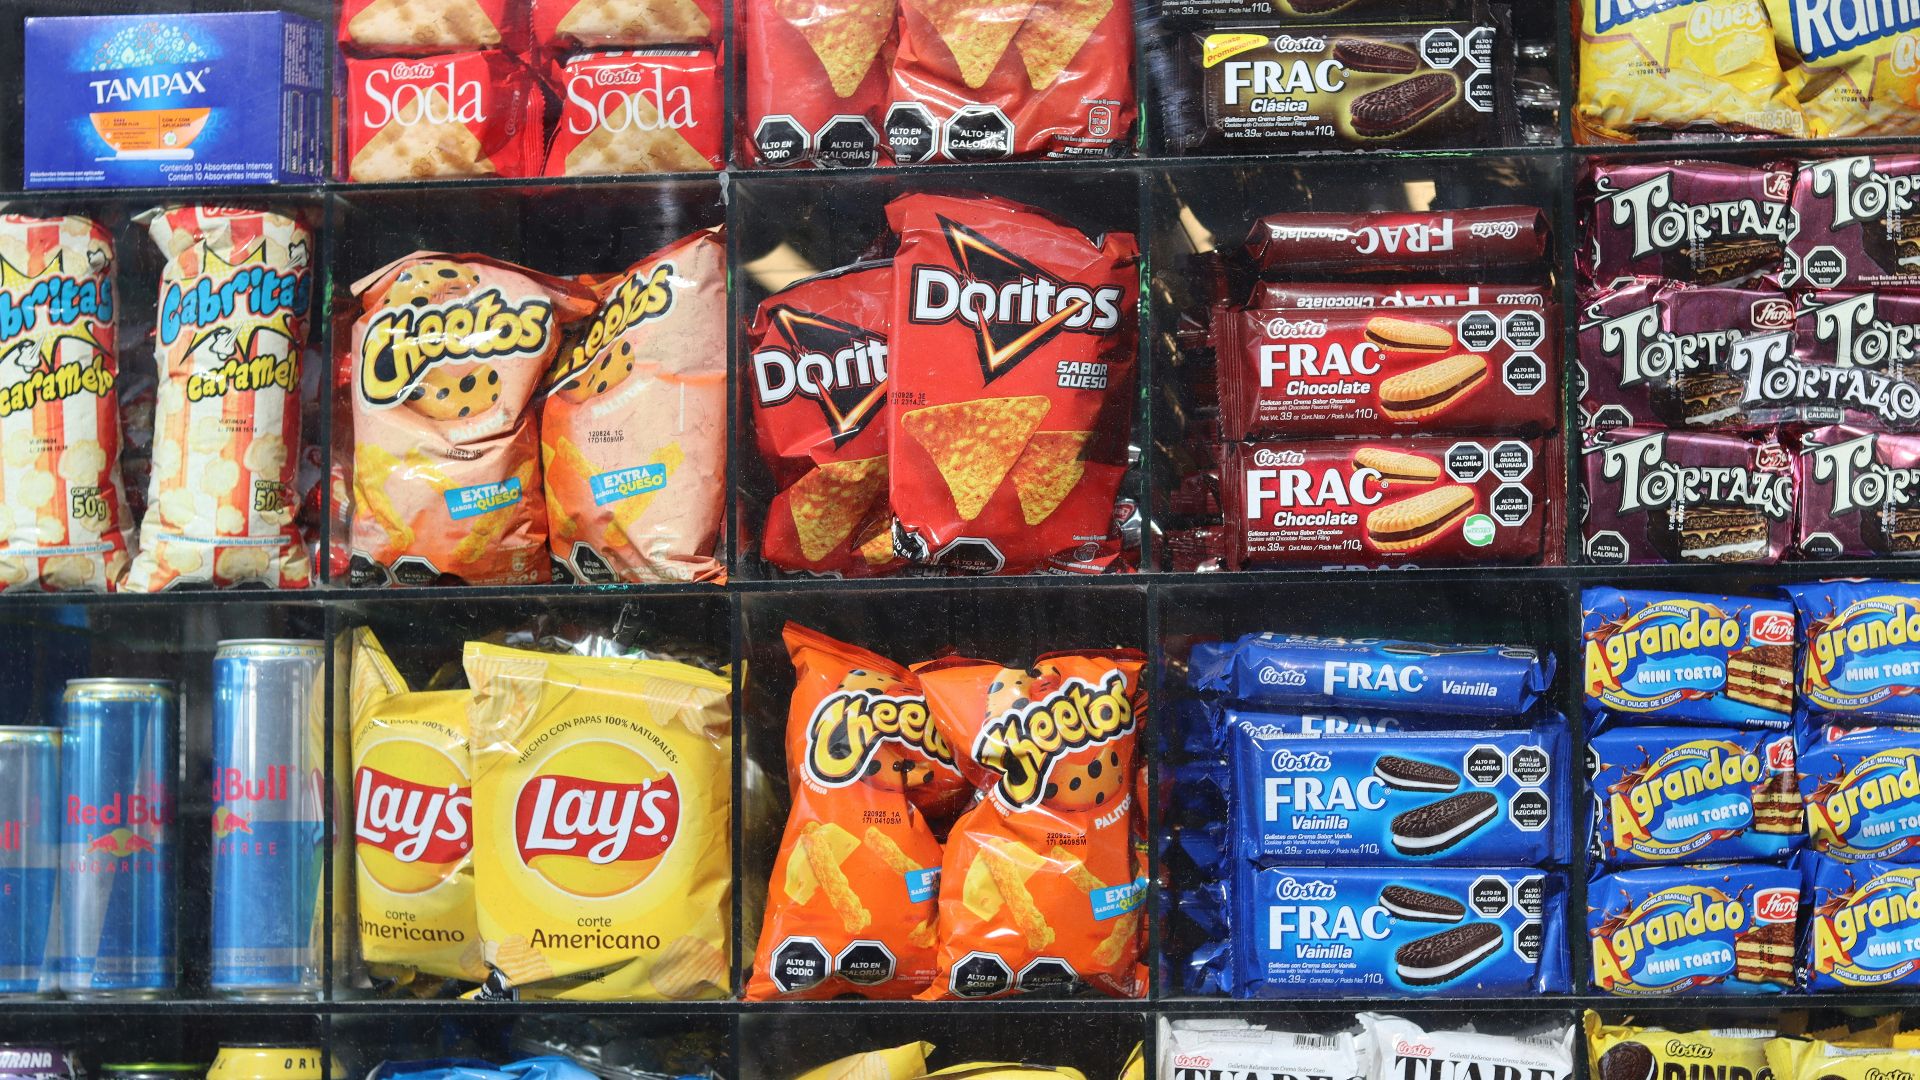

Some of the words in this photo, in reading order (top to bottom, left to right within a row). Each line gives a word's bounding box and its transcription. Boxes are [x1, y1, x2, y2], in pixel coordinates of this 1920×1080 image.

[1207, 37, 1260, 62] Promocional
[1275, 35, 1325, 52] Costa
[1427, 46, 1457, 54] CALORÍAS
[391, 62, 435, 79] Costa
[596, 67, 641, 85] Costa
[89, 69, 206, 104] TAMPAX
[1224, 60, 1346, 105] FRAC
[364, 63, 487, 129] Soda
[568, 68, 698, 135] Soda
[1250, 98, 1308, 113] Clásica
[889, 127, 909, 136] ALTO
[911, 127, 922, 136] EN
[960, 129, 982, 138] ALTO
[1314, 125, 1335, 137] 110g
[831, 141, 850, 150] ALTO
[852, 141, 864, 149] EN
[889, 136, 919, 147] SODIO
[159, 163, 193, 172] Contenido
[203, 162, 244, 171] Absorbentes
[246, 161, 273, 170] Internos
[168, 172, 193, 182] Contém
[195, 172, 202, 180] 10
[203, 171, 245, 180] Absorventes
[246, 170, 272, 180] Internos
[1271, 227, 1348, 243] Chocolate
[1355, 218, 1454, 254] FRAC
[1469, 220, 1518, 240] Costa
[160, 265, 310, 346] Cabritas
[914, 263, 1123, 330] Doritos
[1266, 317, 1326, 339] Costa
[361, 289, 551, 403] Cheetos
[753, 339, 888, 405] Dorit
[1057, 360, 1108, 376] SABOR
[1260, 342, 1380, 387] FRAC
[0, 354, 115, 417] caramelo
[1058, 375, 1107, 390] QUESO
[1286, 380, 1371, 396] Chocolate
[1354, 408, 1373, 418] 110
[1254, 448, 1304, 466] Costa
[595, 489, 615, 499] SABOR
[618, 474, 663, 495] QUESO
[603, 467, 651, 489] EXTRA
[450, 503, 474, 513] SABOR
[476, 488, 519, 511] QUESO
[460, 483, 508, 503] EXTRA
[1247, 469, 1383, 519] FRAC
[72, 497, 107, 521] 50g
[1495, 503, 1527, 511] AZÚCARES
[1273, 511, 1358, 527] Chocolate
[1342, 539, 1362, 551] 110g
[1638, 604, 1661, 620] DOBLE
[1662, 605, 1690, 617] MANJAR
[1867, 602, 1896, 613] MANJAR
[1584, 609, 1740, 696] Agrandao
[1258, 665, 1307, 686] Costa
[1323, 661, 1425, 696] FRAC
[1441, 679, 1498, 697] Vainilla
[1638, 668, 1673, 684] MINI
[1675, 665, 1723, 680] TORTA
[1846, 666, 1881, 682] MINI
[1884, 663, 1920, 678] TORT
[1603, 692, 1626, 705] DOBLE
[1627, 699, 1648, 708] DULCE
[1648, 699, 1657, 707] DE
[1658, 690, 1682, 706] LECHE
[1813, 690, 1835, 704] DOBLE
[1836, 697, 1858, 706] DULCE
[1858, 696, 1868, 705] DE
[1868, 688, 1891, 703] LECHE
[421, 720, 445, 734] 100%
[519, 738, 549, 764] HECHO
[549, 720, 573, 738] CON
[572, 715, 603, 728] PAPAS
[604, 715, 629, 730] 100%
[629, 722, 678, 764] NATURALES
[975, 676, 1133, 804] Cheetos
[1272, 748, 1332, 772] Costa
[1659, 752, 1680, 767] DOBLE
[1681, 748, 1709, 759] MANJAR
[1854, 760, 1876, 775] DOBLE
[1876, 757, 1906, 768] MANJAR
[224, 764, 288, 801] Bull
[1264, 776, 1386, 822] FRAC
[1609, 747, 1760, 850] Agrandao
[67, 793, 121, 825] Red
[355, 767, 473, 863] Lay's
[1094, 794, 1133, 829] PALITOS
[1666, 814, 1699, 831] MINI
[1701, 802, 1749, 822] TORTA
[525, 777, 672, 865] Lay's
[1291, 814, 1349, 831] Vainilla
[1863, 821, 1897, 838] MINI
[1359, 843, 1380, 855] 110g
[1635, 843, 1658, 853] DOBLE
[1659, 846, 1682, 855] DULCE
[1681, 844, 1691, 852] DE
[1691, 833, 1712, 851] LECHE
[1875, 849, 1885, 858] DE
[1885, 840, 1908, 856] LECHE
[1276, 877, 1336, 901] Costa
[385, 909, 416, 923] corte
[1095, 905, 1115, 914] SABOR
[576, 915, 612, 928] corte
[1269, 905, 1392, 950] FRAC
[530, 928, 661, 951] Americano
[1591, 892, 1745, 992] Agrandao
[1868, 940, 1901, 957] MINI
[1295, 943, 1353, 960] Vainilla
[785, 958, 806, 966] ALTO
[805, 958, 816, 966] EN
[850, 961, 870, 970] ALTO
[871, 961, 881, 970] EN
[1647, 958, 1681, 975] MINI
[1682, 949, 1732, 967] TORTA
[1835, 967, 1858, 979] DOBLE
[1859, 972, 1881, 980] DULCE
[1882, 971, 1892, 980] DE
[1892, 962, 1914, 978] LECHE
[786, 966, 814, 977] SODIO
[966, 973, 987, 982] ALTO
[987, 974, 998, 982] EN
[1363, 973, 1384, 984] 110g
[966, 980, 995, 989] SODIO
[1665, 1039, 1713, 1058] Costa
